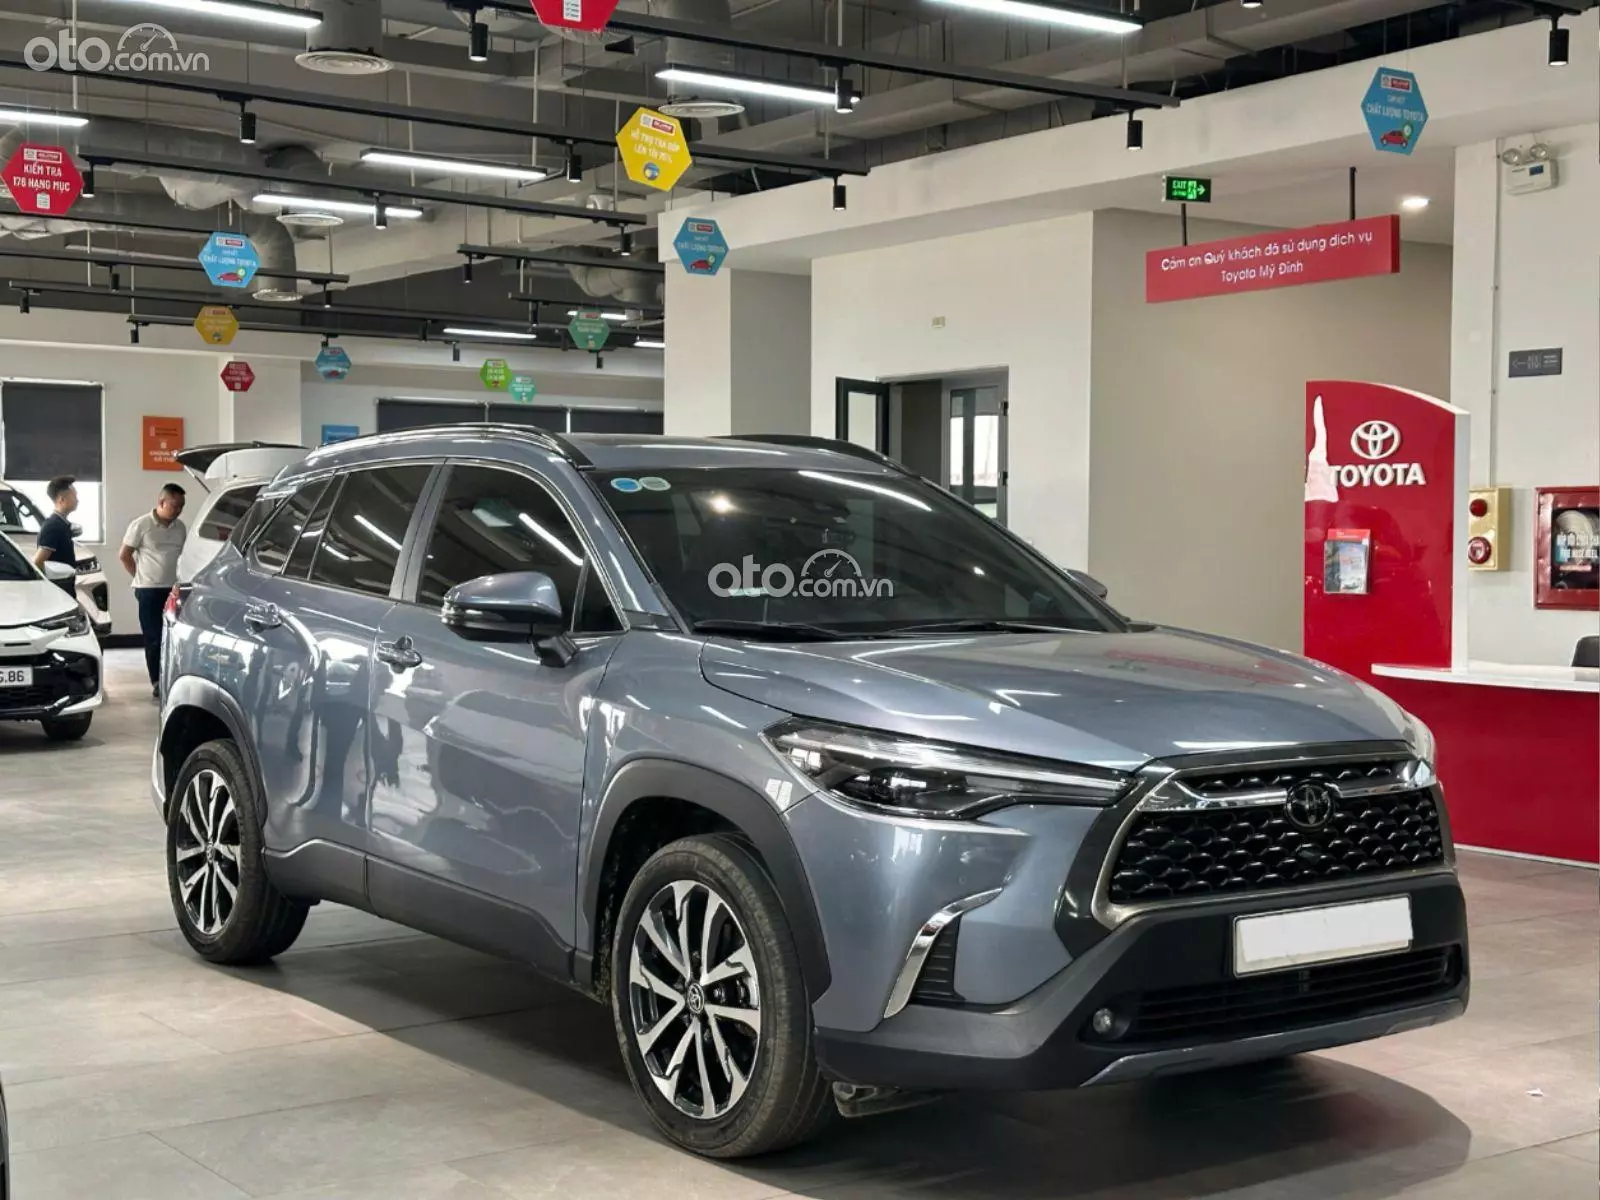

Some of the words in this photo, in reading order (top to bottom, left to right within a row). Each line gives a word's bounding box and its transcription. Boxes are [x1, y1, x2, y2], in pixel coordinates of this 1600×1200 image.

[45, 165, 62, 177] TRA
[28, 177, 51, 191] HẠNG
[53, 181, 71, 194] MỤC
[1172, 180, 1187, 189] EXIT
[1204, 249, 1225, 265] Quý
[1228, 245, 1262, 261] khách
[1264, 243, 1280, 256] đã
[1297, 238, 1326, 254] dụng
[1329, 232, 1355, 249] dịch
[1358, 231, 1373, 246] vụ
[1221, 266, 1256, 283] Toyota
[1259, 263, 1275, 279] Mỹ
[1328, 463, 1426, 488] TOYOTA
